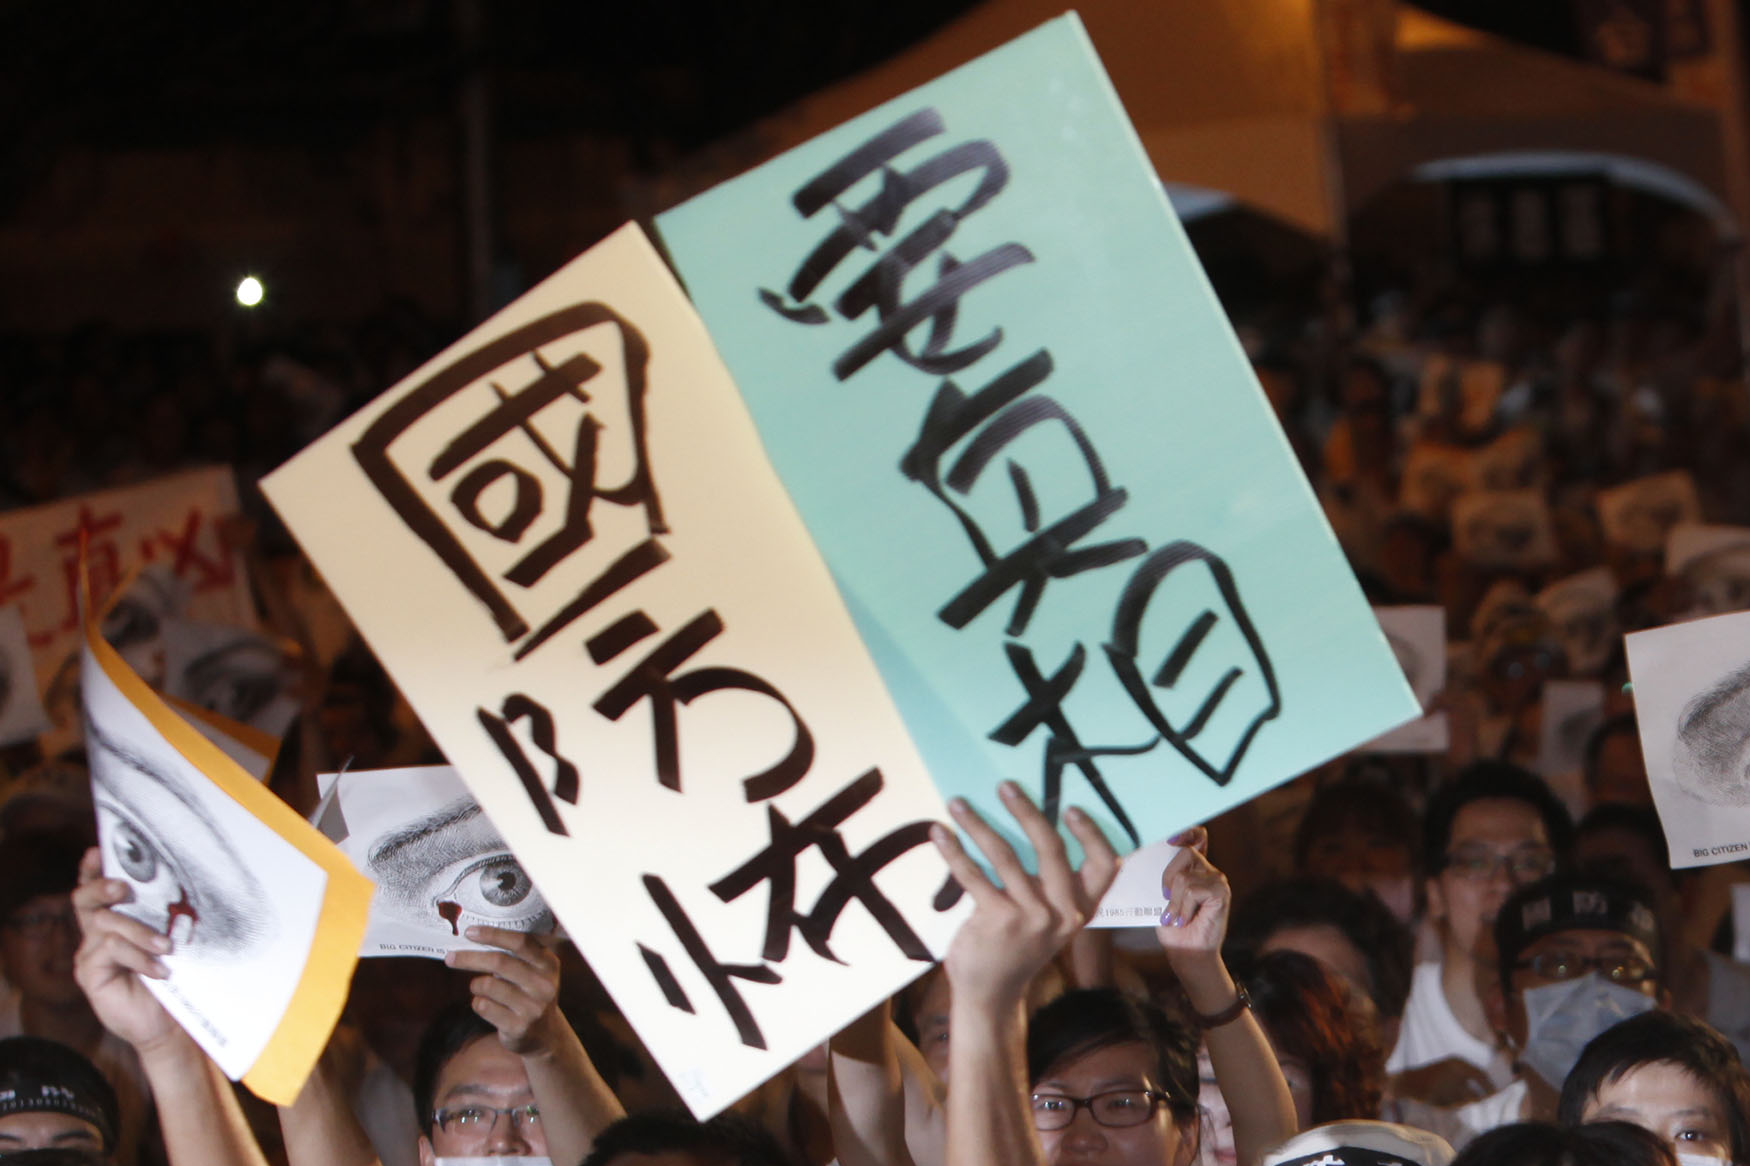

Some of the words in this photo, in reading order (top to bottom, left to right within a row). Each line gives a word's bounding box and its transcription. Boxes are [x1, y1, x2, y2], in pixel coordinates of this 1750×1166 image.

[1693, 848, 1710, 858] BIG
[1711, 842, 1748, 856] CITIZEN
[380, 943, 396, 951] BIG
[398, 944, 434, 953] CITIZEN
